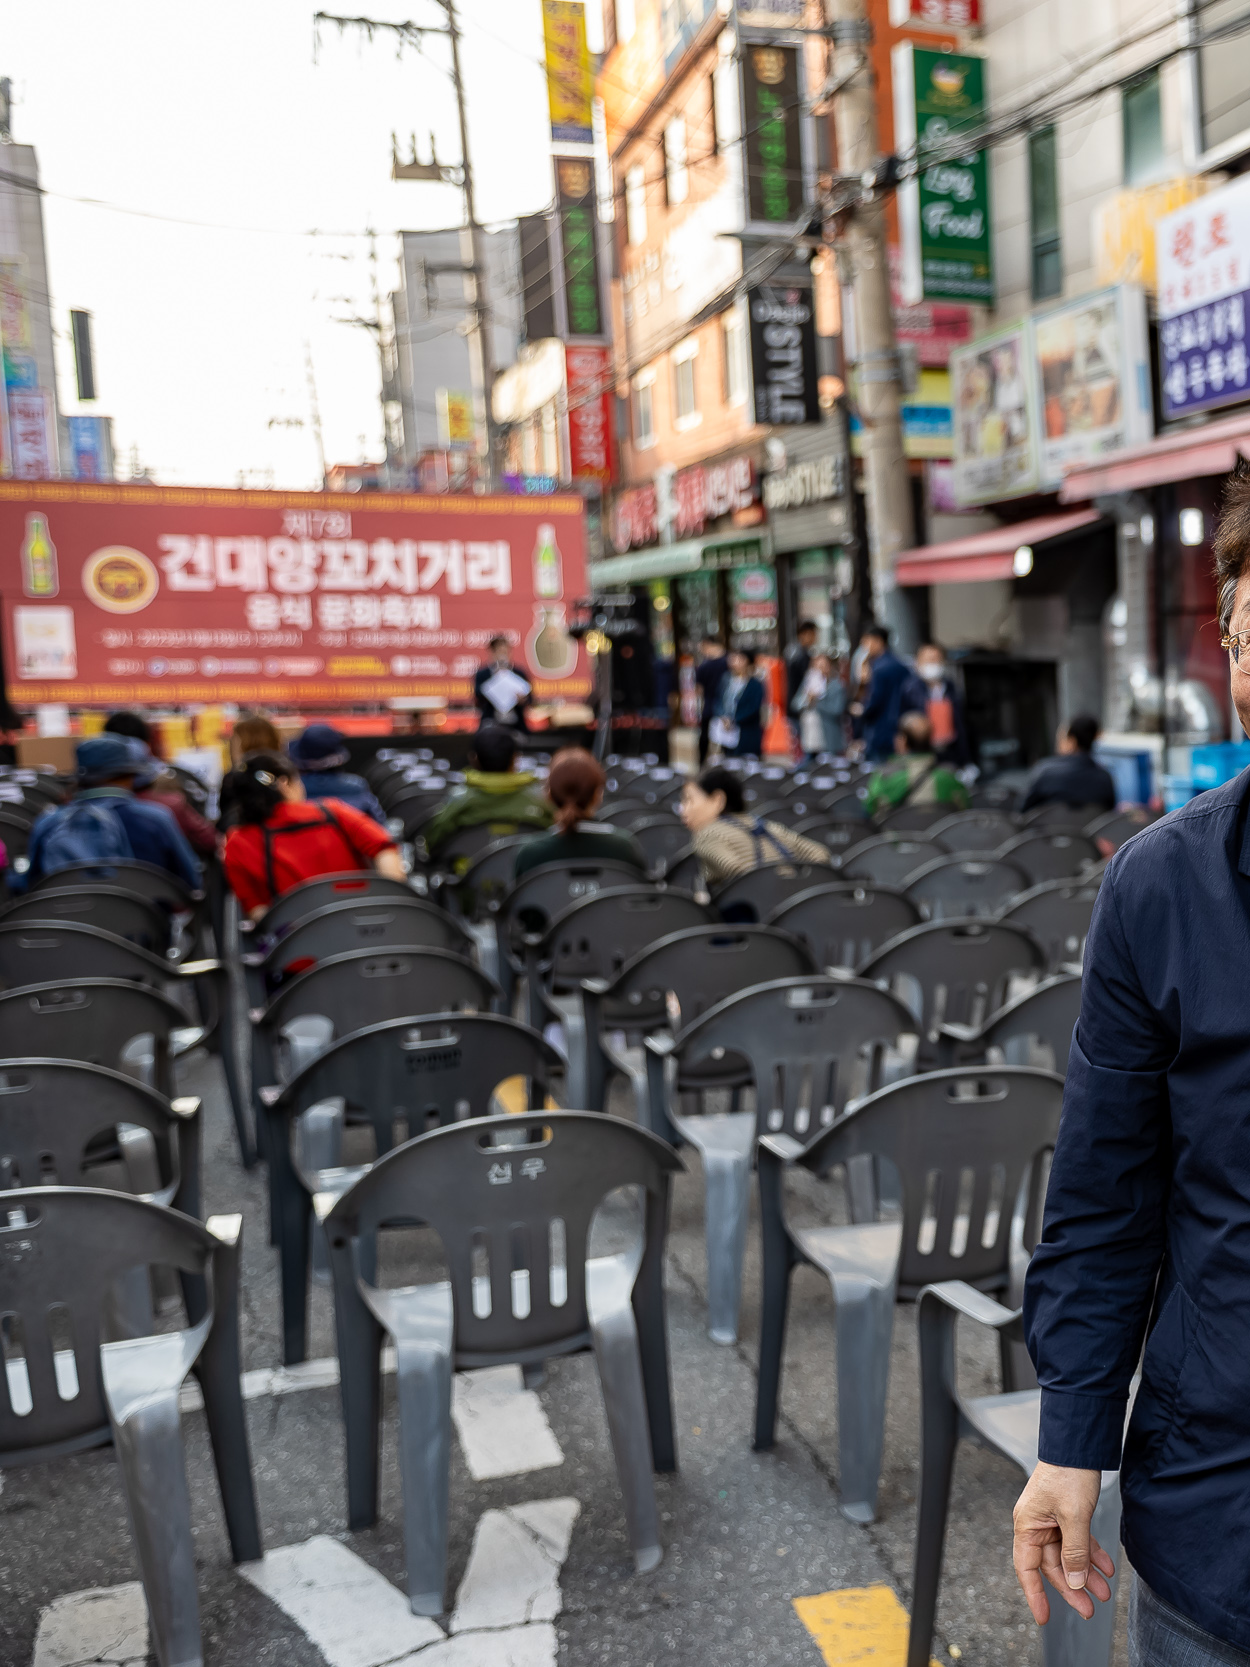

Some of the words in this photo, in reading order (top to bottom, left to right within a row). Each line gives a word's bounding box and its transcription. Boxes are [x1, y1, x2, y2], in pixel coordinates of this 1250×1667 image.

[282, 510, 352, 538] 제7회
[158, 533, 512, 595] 건대양꼬치거리
[247, 594, 312, 630] 음식
[317, 594, 441, 631] 문화축제
